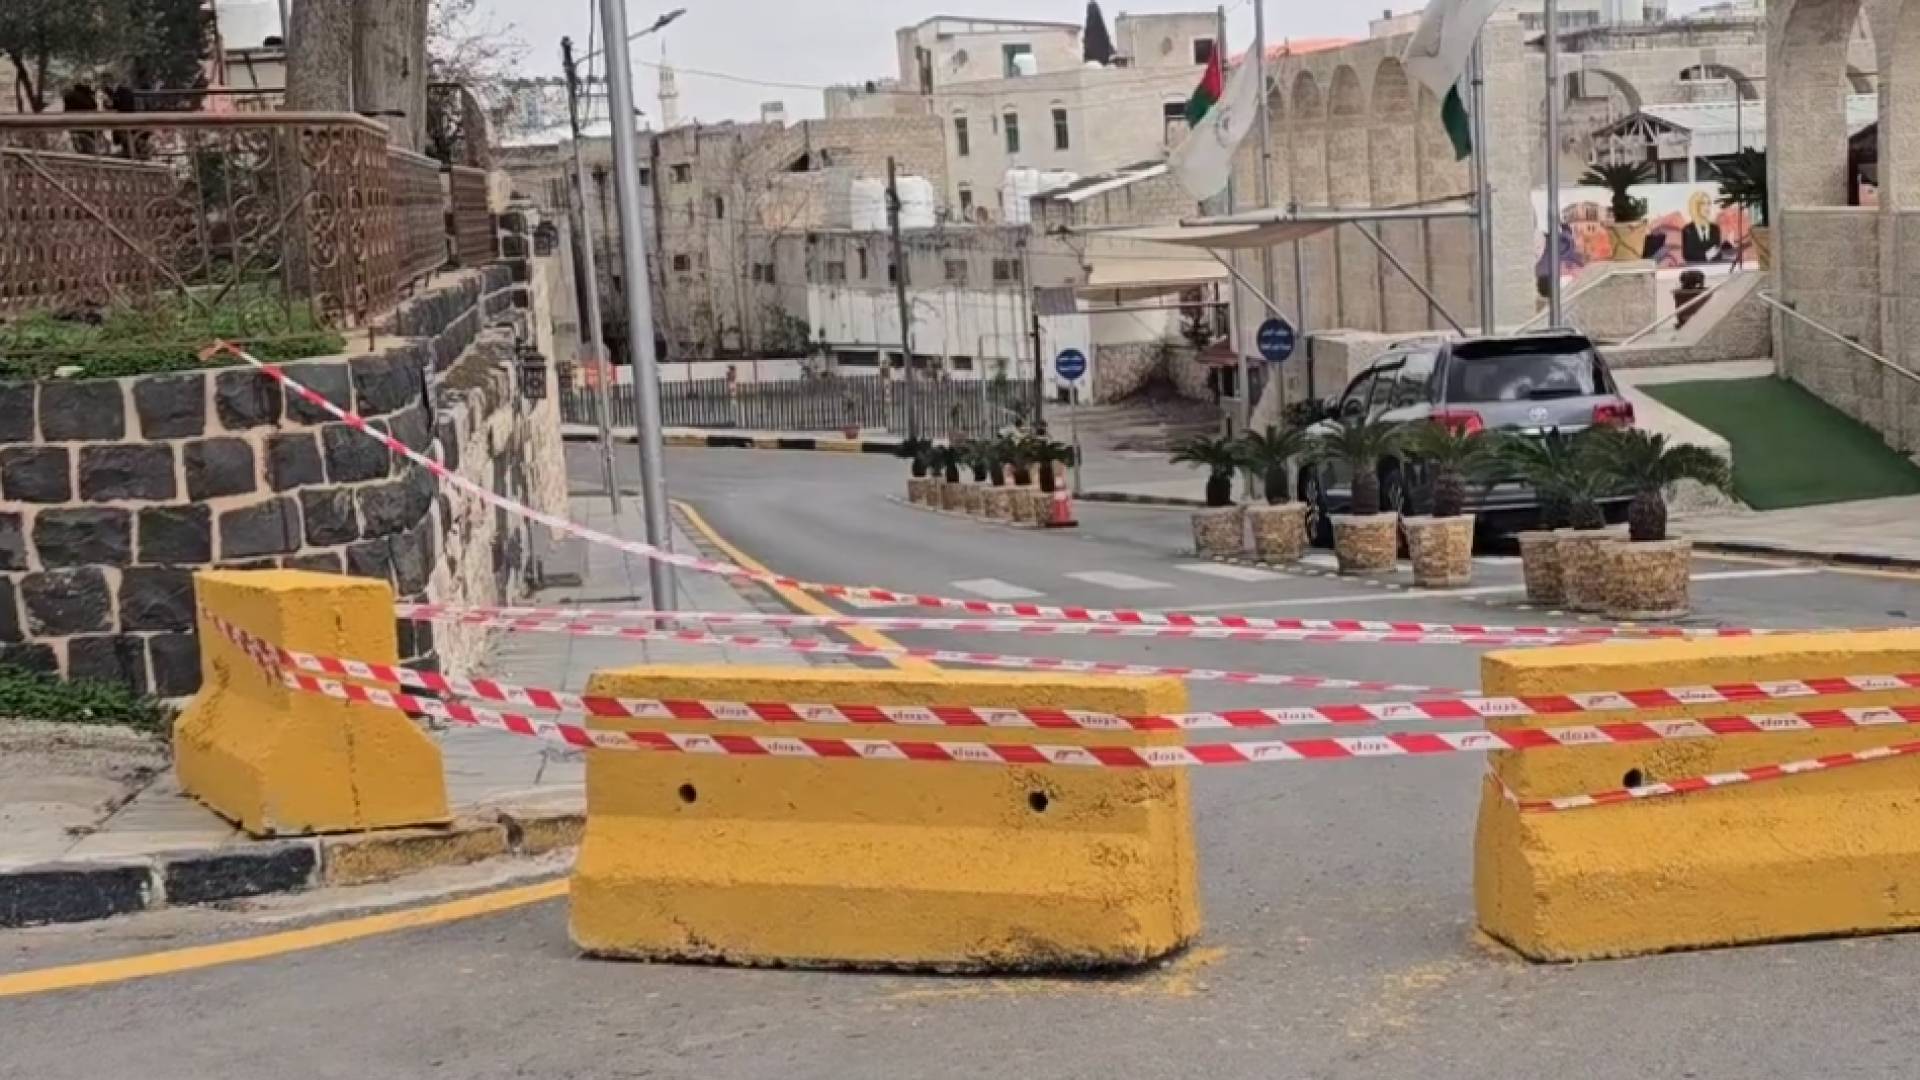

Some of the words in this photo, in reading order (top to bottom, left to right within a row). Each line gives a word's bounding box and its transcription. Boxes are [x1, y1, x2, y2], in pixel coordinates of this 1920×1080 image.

[1479, 701, 1518, 713] stop
[1277, 711, 1315, 721] stop
[1350, 739, 1389, 751] stop
